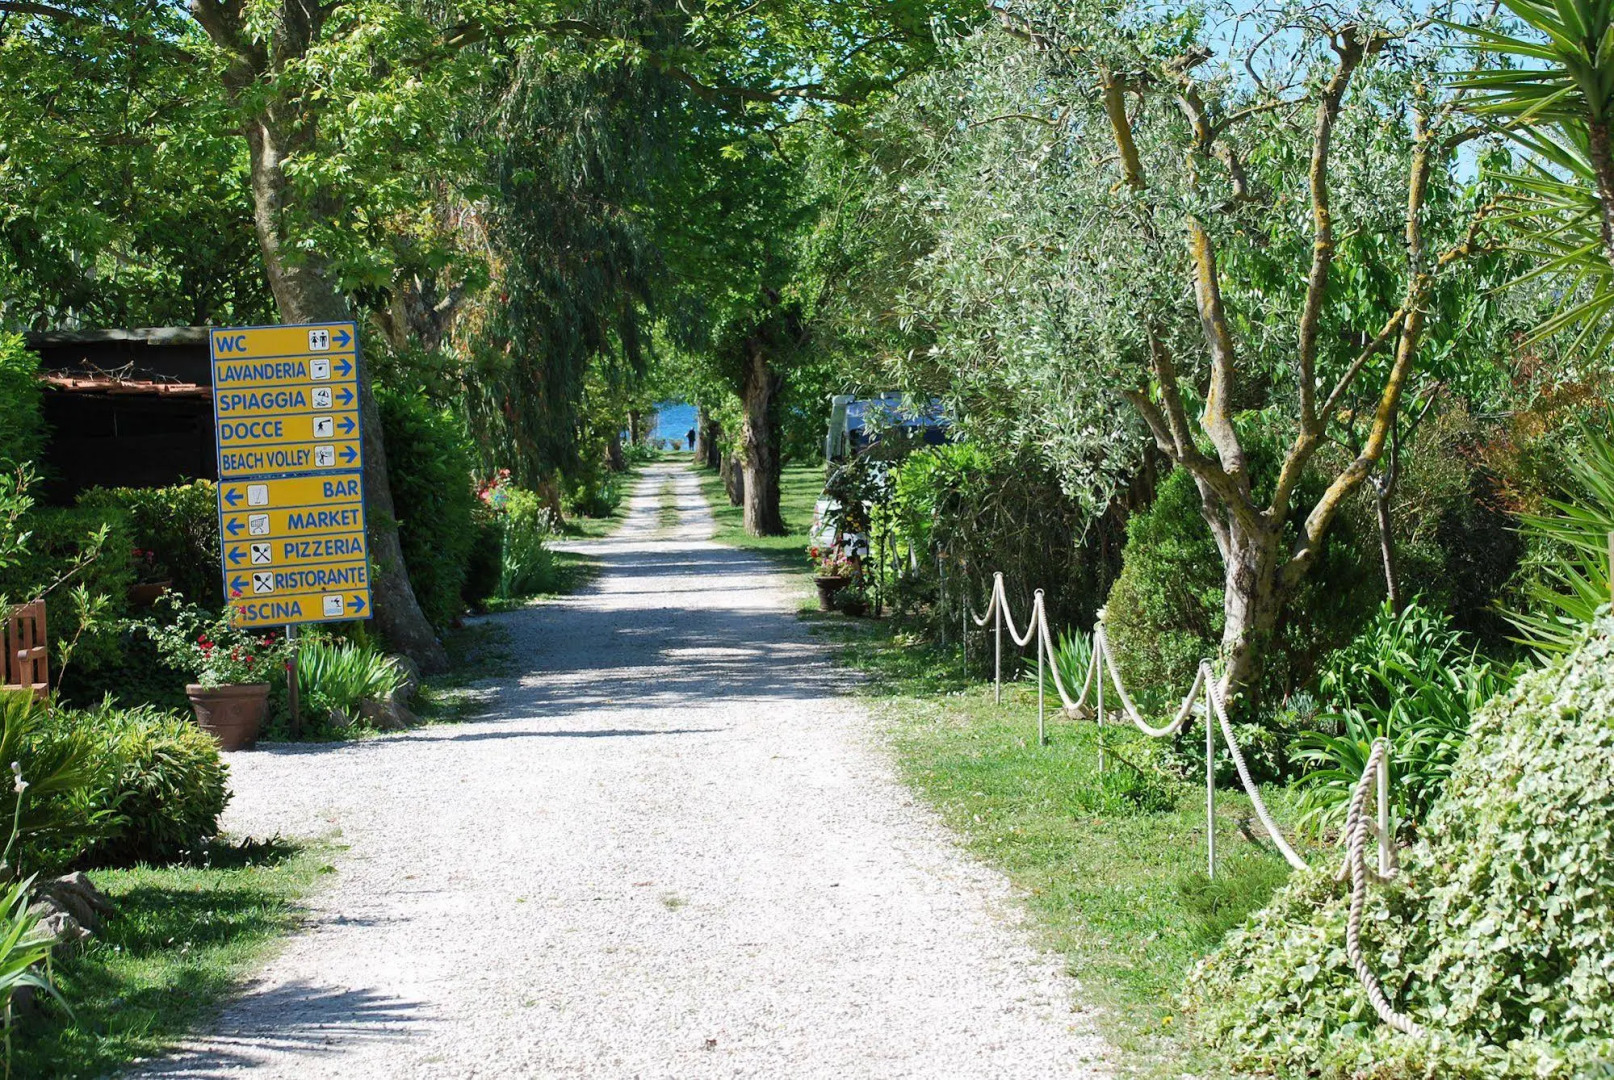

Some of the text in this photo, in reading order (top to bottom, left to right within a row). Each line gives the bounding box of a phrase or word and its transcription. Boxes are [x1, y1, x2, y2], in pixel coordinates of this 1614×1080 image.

[216, 335, 247, 353] WC
[217, 361, 307, 382] LAVANDERIA
[220, 391, 307, 412] SPIAGGIA
[221, 421, 283, 440] DOCCE
[222, 449, 310, 471] BEACH VOLLEY
[323, 479, 359, 498] BAR
[287, 509, 359, 530] MARKET
[284, 537, 363, 559] PIZZERIA
[275, 566, 366, 589] RISTORANTE
